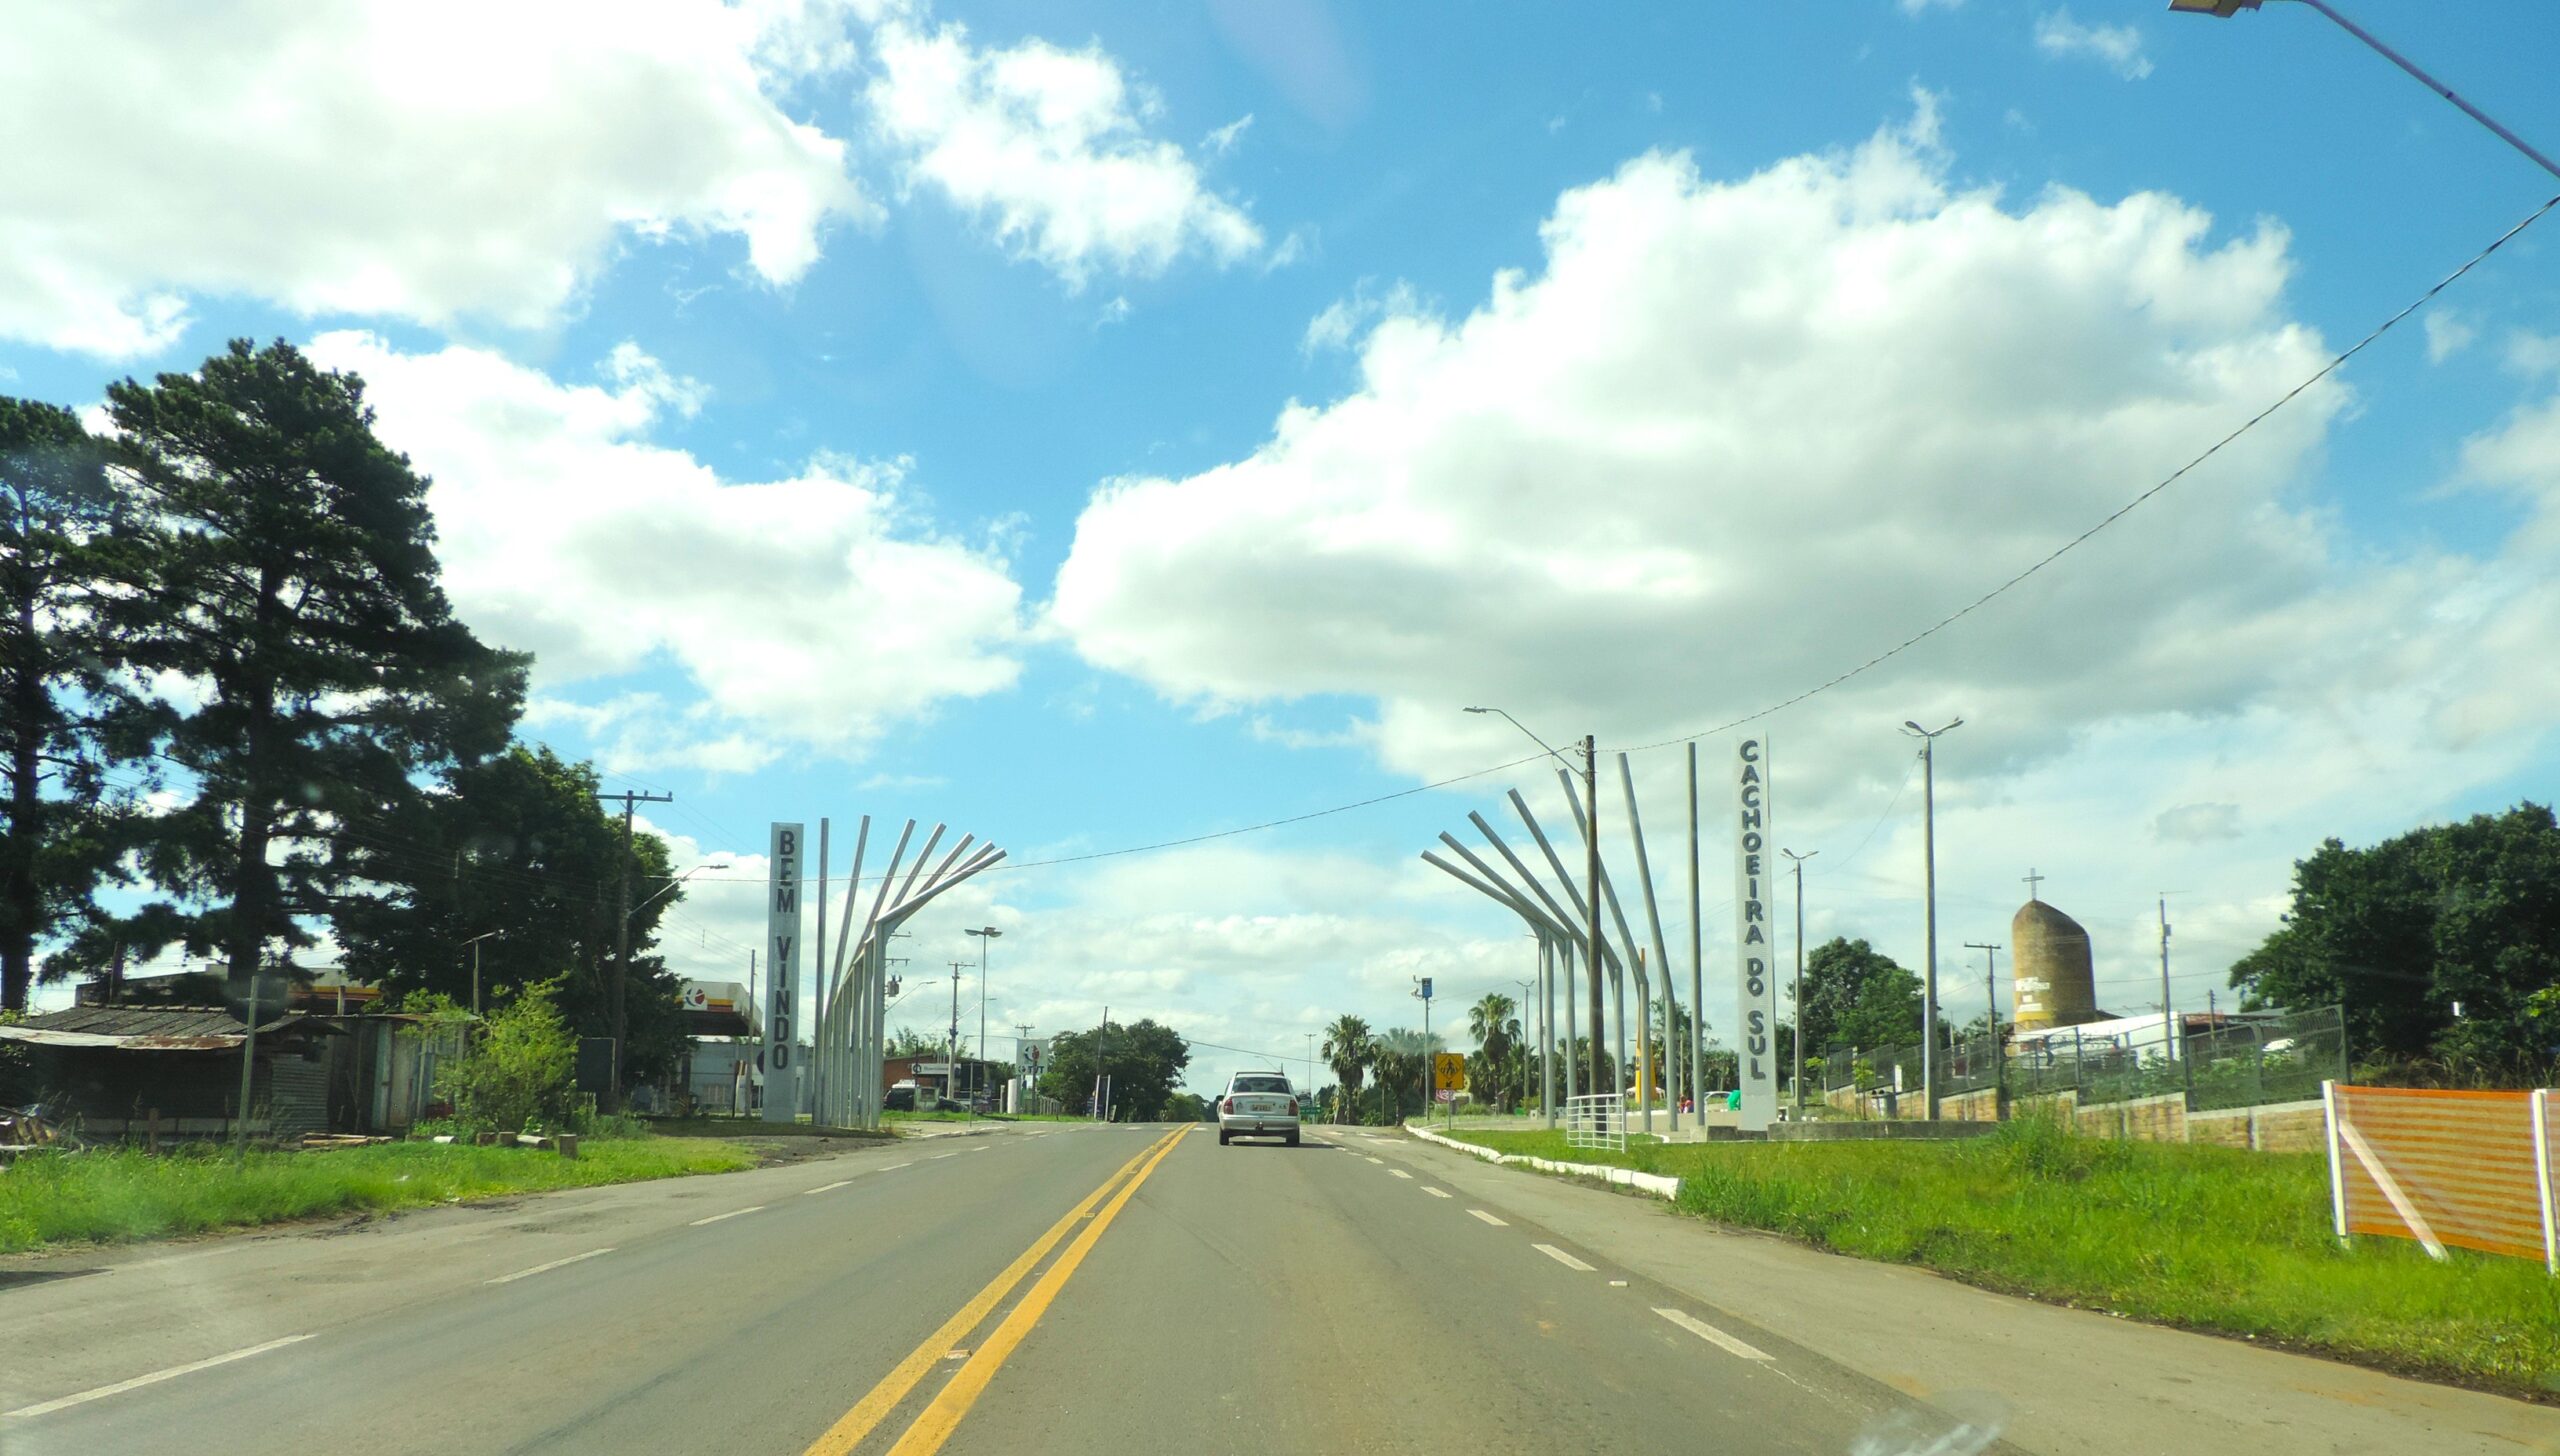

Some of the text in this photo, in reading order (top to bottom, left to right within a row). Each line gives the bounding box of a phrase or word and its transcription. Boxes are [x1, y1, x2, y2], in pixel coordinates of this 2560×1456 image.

[772, 830, 795, 1070] BEM VINDO
[1739, 740, 1766, 1080] CACHOEIRA DO SUL
